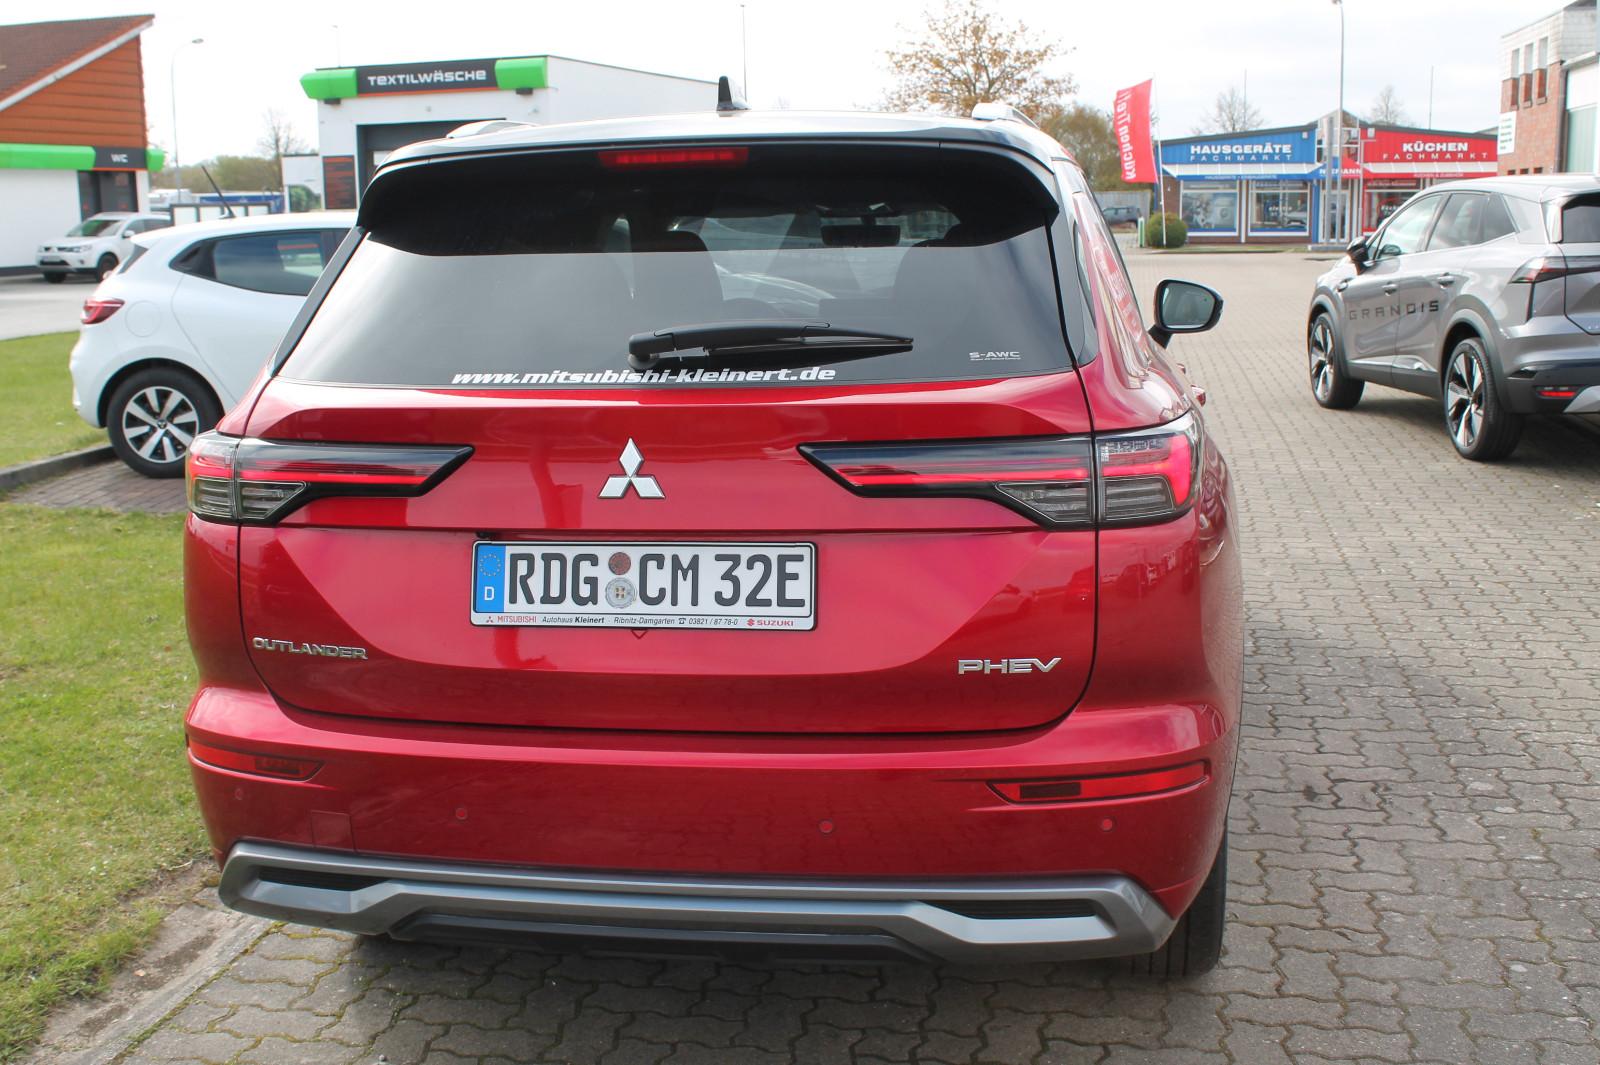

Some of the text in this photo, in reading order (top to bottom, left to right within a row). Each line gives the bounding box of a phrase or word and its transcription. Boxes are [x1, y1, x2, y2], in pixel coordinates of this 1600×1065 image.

[1190, 142, 1292, 154] HAUSGERÄTE
[1402, 140, 1468, 152] KÜCHEN
[110, 153, 128, 163] WC
[1383, 152, 1488, 160] FACHMARKT
[1349, 300, 1439, 320] GRANDIS
[452, 366, 836, 385] www.mitsubishi-kleinert.de
[508, 552, 806, 608] RDG CM 32E
[484, 586, 495, 601] D
[497, 615, 537, 623] MITSUBISHI
[542, 616, 573, 624] Autohaus
[574, 616, 605, 624] Kleinert
[614, 616, 675, 626] Ribnitz-Damgarten
[252, 637, 368, 660] OUTLANDER
[957, 657, 1062, 674] PHEV
